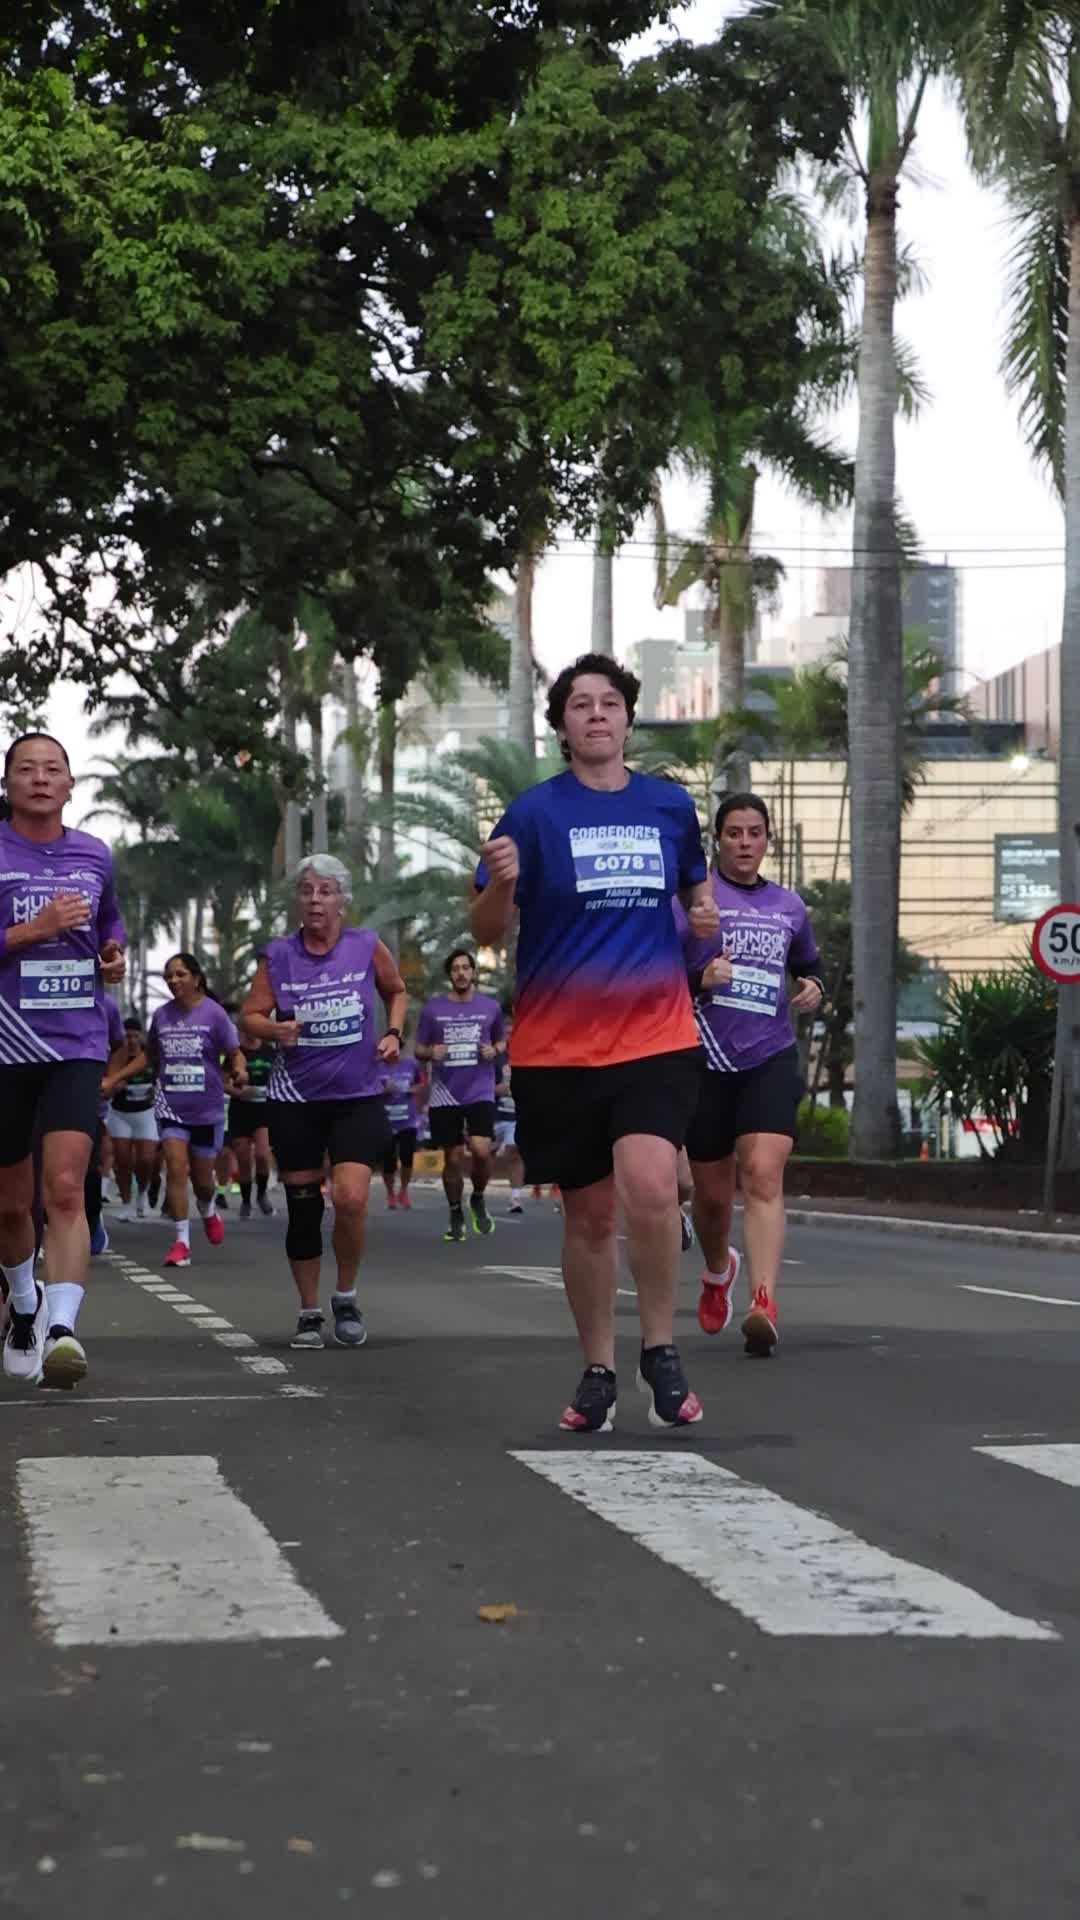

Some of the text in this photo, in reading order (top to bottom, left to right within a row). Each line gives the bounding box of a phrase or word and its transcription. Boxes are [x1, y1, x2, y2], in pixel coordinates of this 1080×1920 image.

[569, 825, 660, 840] CORREDORES
[594, 855, 645, 871] 6078
[722, 929, 785, 944] MUNDO
[1049, 922, 1080, 954] 50
[38, 977, 80, 992] 6310
[731, 981, 768, 998] 5952
[310, 1020, 348, 1033] 6066
